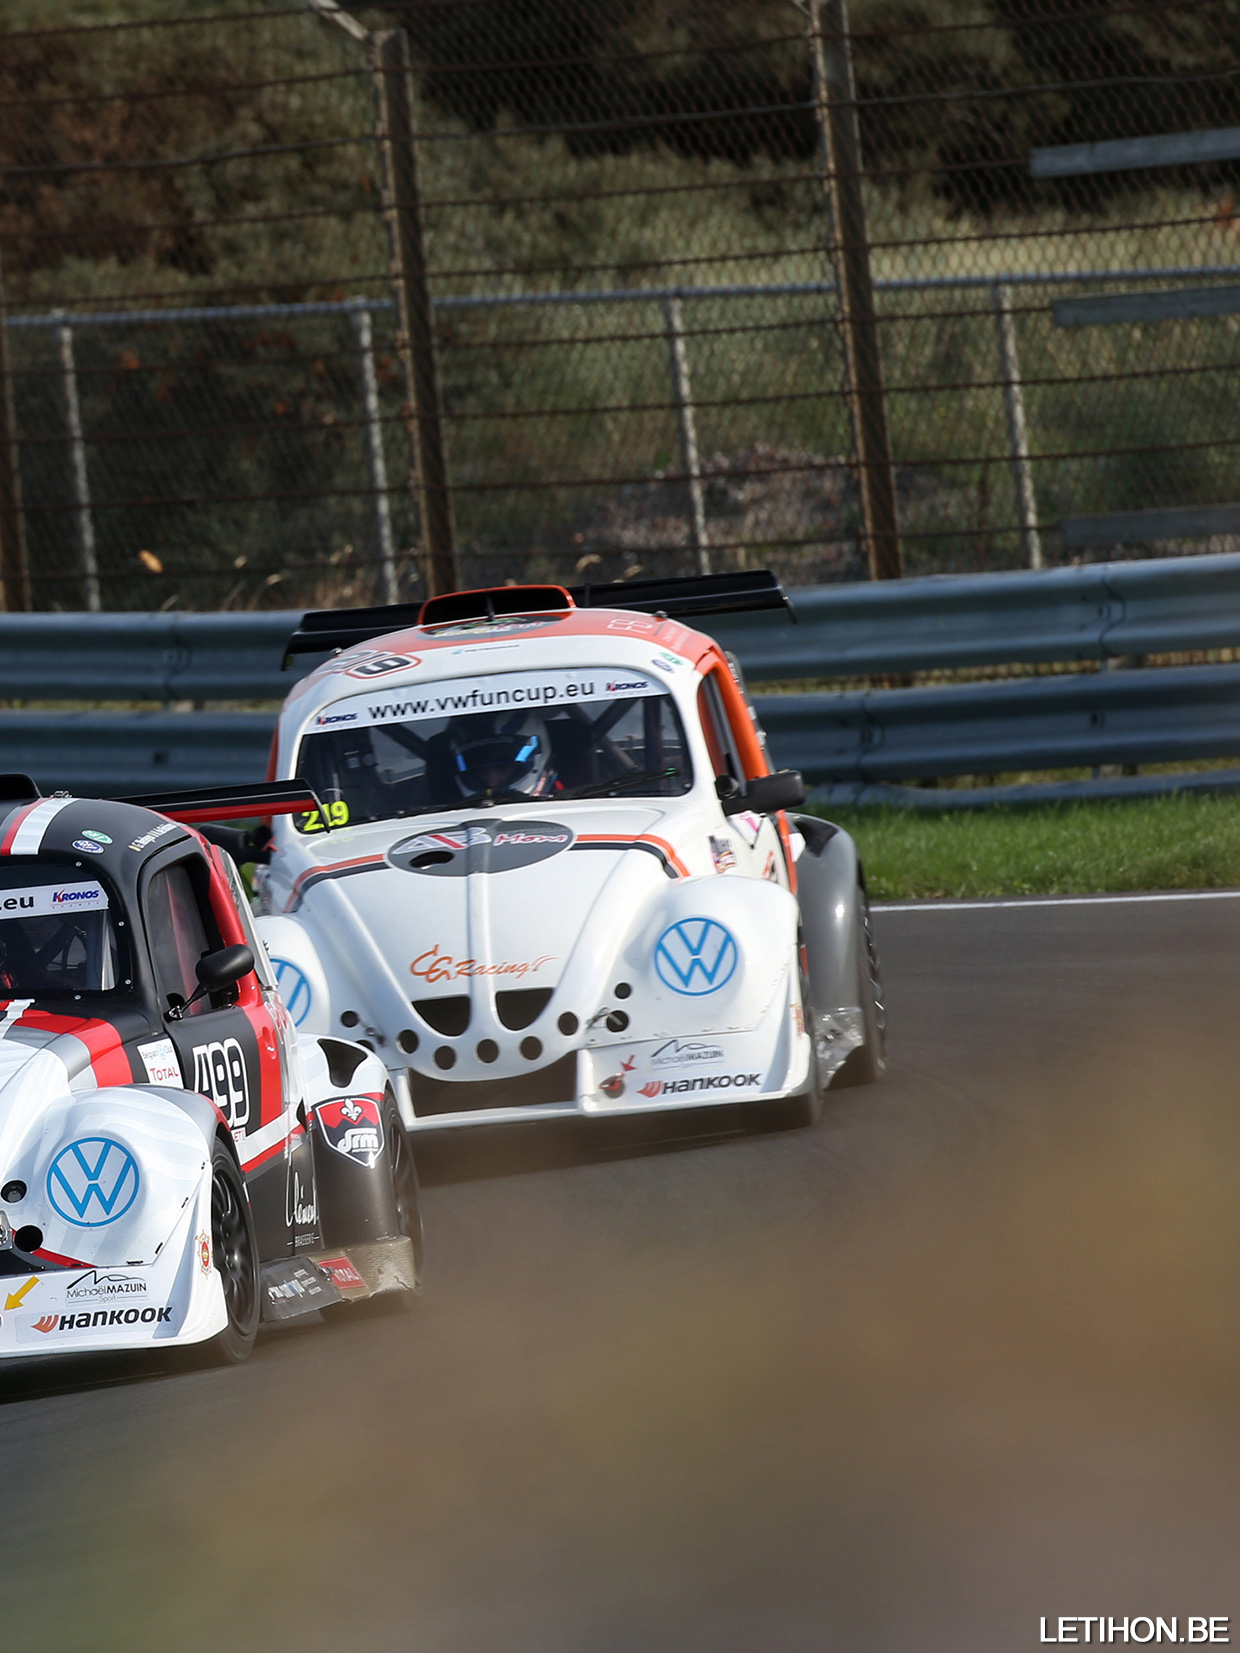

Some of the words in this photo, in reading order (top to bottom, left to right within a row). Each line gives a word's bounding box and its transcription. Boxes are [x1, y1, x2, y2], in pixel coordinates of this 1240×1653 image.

[368, 681, 594, 720] www.vwfuncup.eu
[52, 888, 100, 902] KRONOS
[99, 1295, 117, 1303] Sport
